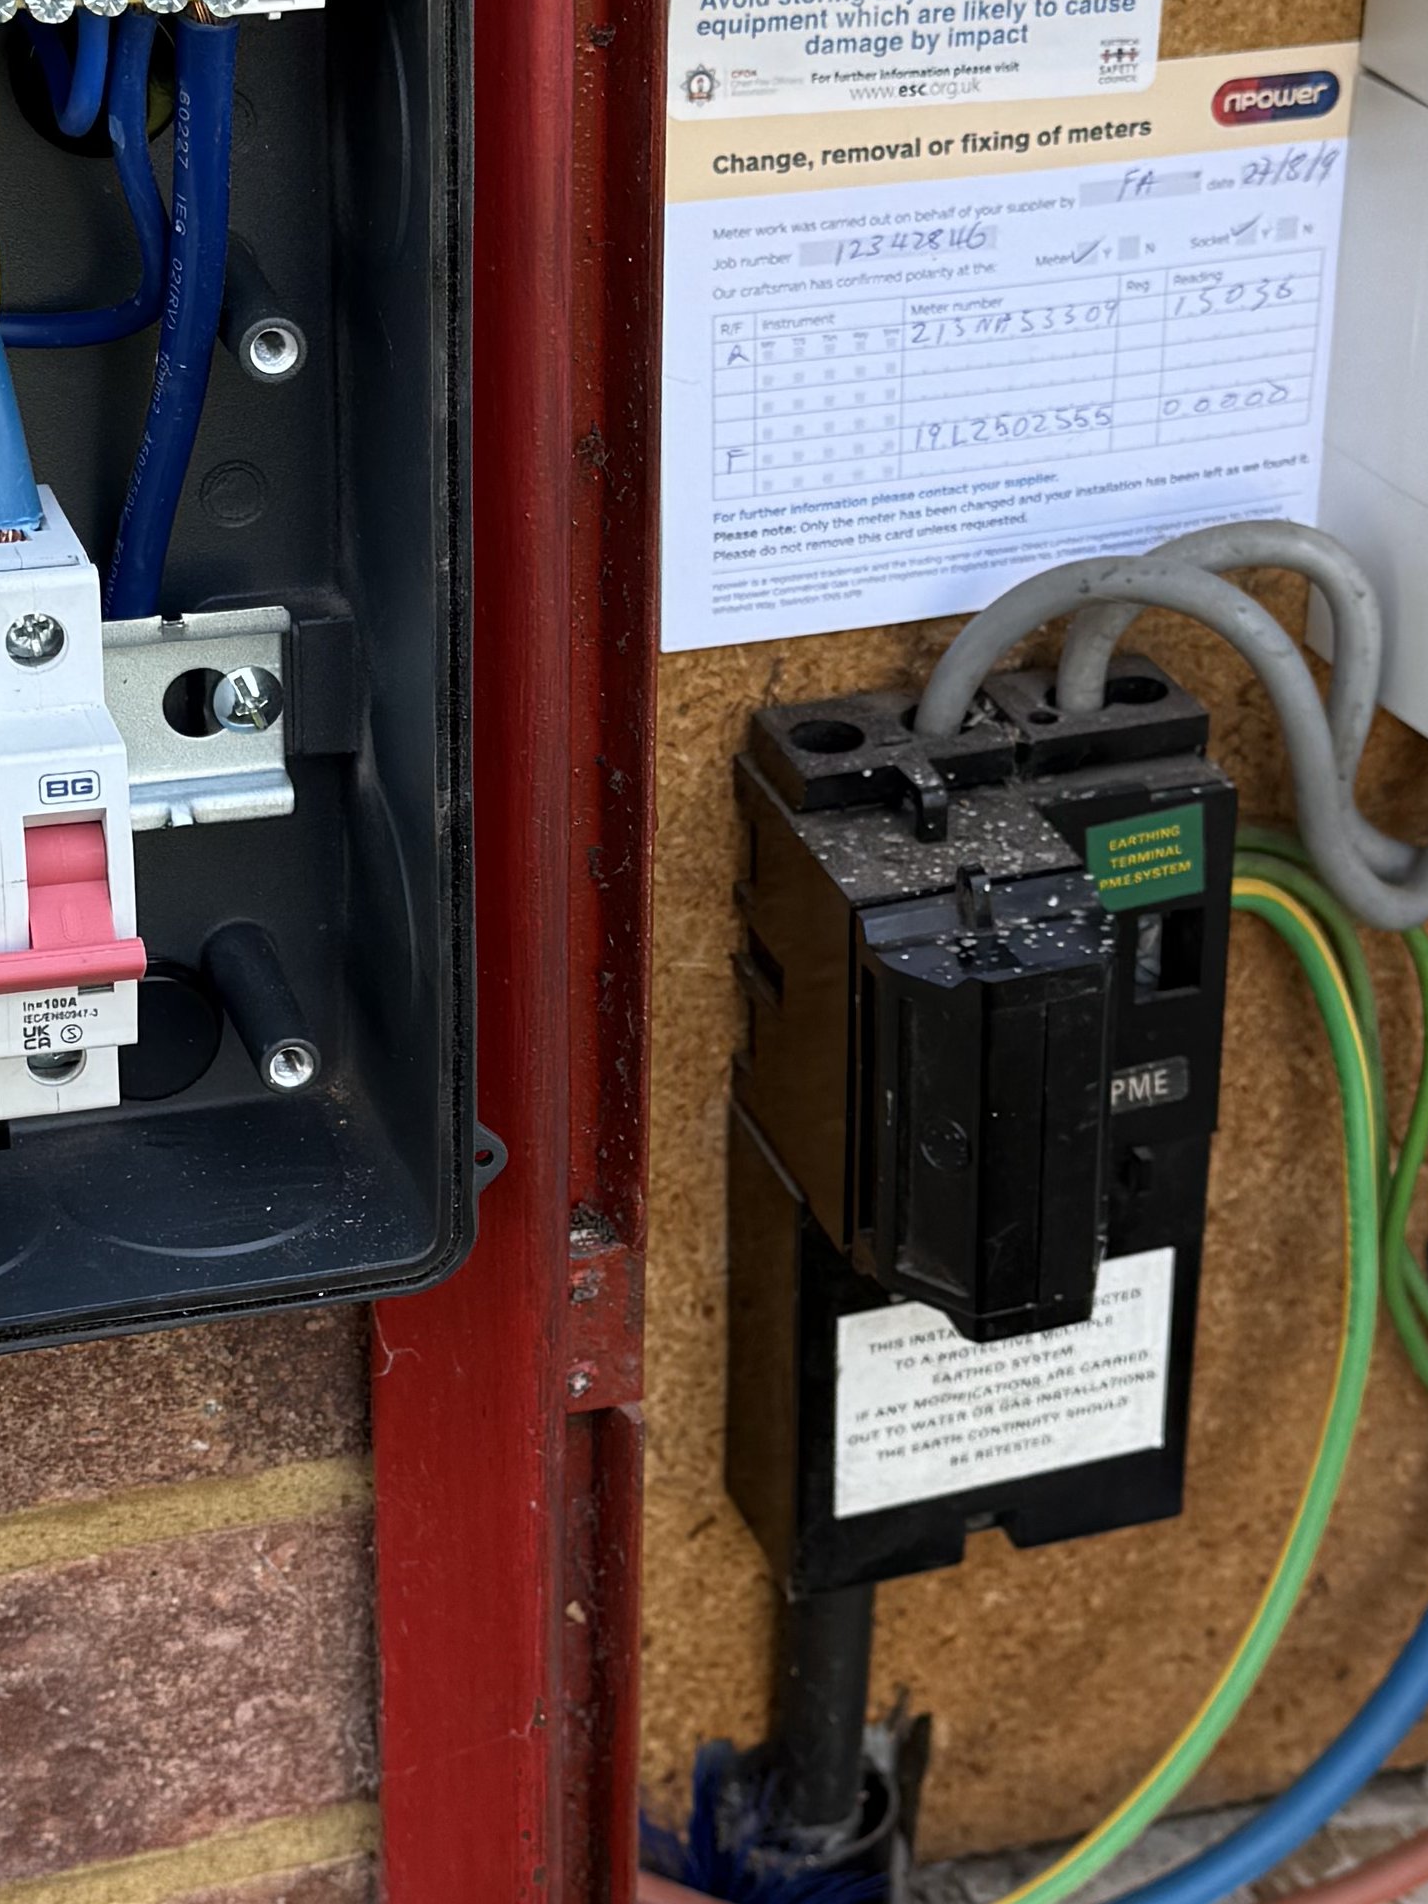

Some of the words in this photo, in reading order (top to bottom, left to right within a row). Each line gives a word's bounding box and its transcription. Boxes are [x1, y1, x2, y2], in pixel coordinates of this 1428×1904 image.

[696, 9, 828, 40] equipment
[836, 4, 909, 29] which
[918, 4, 955, 25] are
[1034, 0, 1057, 18] to
[805, 34, 904, 58] damage
[911, 27, 940, 55] by
[948, 24, 1029, 52] impact
[811, 71, 831, 85] For
[834, 70, 877, 84] further
[880, 65, 951, 81] information
[953, 62, 992, 77] please
[995, 61, 1020, 73] visit
[849, 77, 982, 101] www.esc.org.uk
[1224, 82, 1329, 113] npower
[713, 153, 814, 175] Change,
[821, 137, 922, 166] removal
[928, 139, 954, 157] or
[962, 132, 1030, 154] fixing
[1037, 125, 1062, 146] of
[1068, 120, 1152, 144] meters
[712, 257, 737, 271] Job
[740, 253, 792, 268] number
[712, 287, 736, 300] Our
[740, 281, 807, 298] craftsman
[810, 279, 833, 291] has
[836, 272, 902, 288] confirmed
[905, 267, 953, 283] polarity
[956, 265, 971, 276] at
[721, 322, 743, 337] R/F
[762, 313, 836, 331] Instrument
[910, 303, 950, 316] Meter
[952, 297, 1004, 312] number
[1174, 270, 1223, 286] Reading
[713, 511, 736, 524] For
[739, 506, 787, 521] further
[789, 495, 868, 516] information
[871, 489, 915, 507] please
[918, 482, 968, 500] contact
[972, 480, 1002, 497] your
[46, 777, 93, 798] BG
[1108, 824, 1181, 852] EARTHING
[1109, 844, 1182, 869] TERMINAL
[1133, 860, 1192, 884] SYSTEM
[23, 1024, 51, 1038] UK
[24, 1037, 52, 1051] CA
[1111, 1068, 1169, 1106] PME
[875, 1402, 908, 1418] ANY
[912, 1376, 1042, 1411] MODIFICATIONS
[1046, 1366, 1076, 1383] ARE
[1080, 1349, 1149, 1373] CARRIED
[932, 1361, 1006, 1385] EARTHED
[885, 1423, 907, 1439] TO
[910, 1410, 968, 1433] WATER
